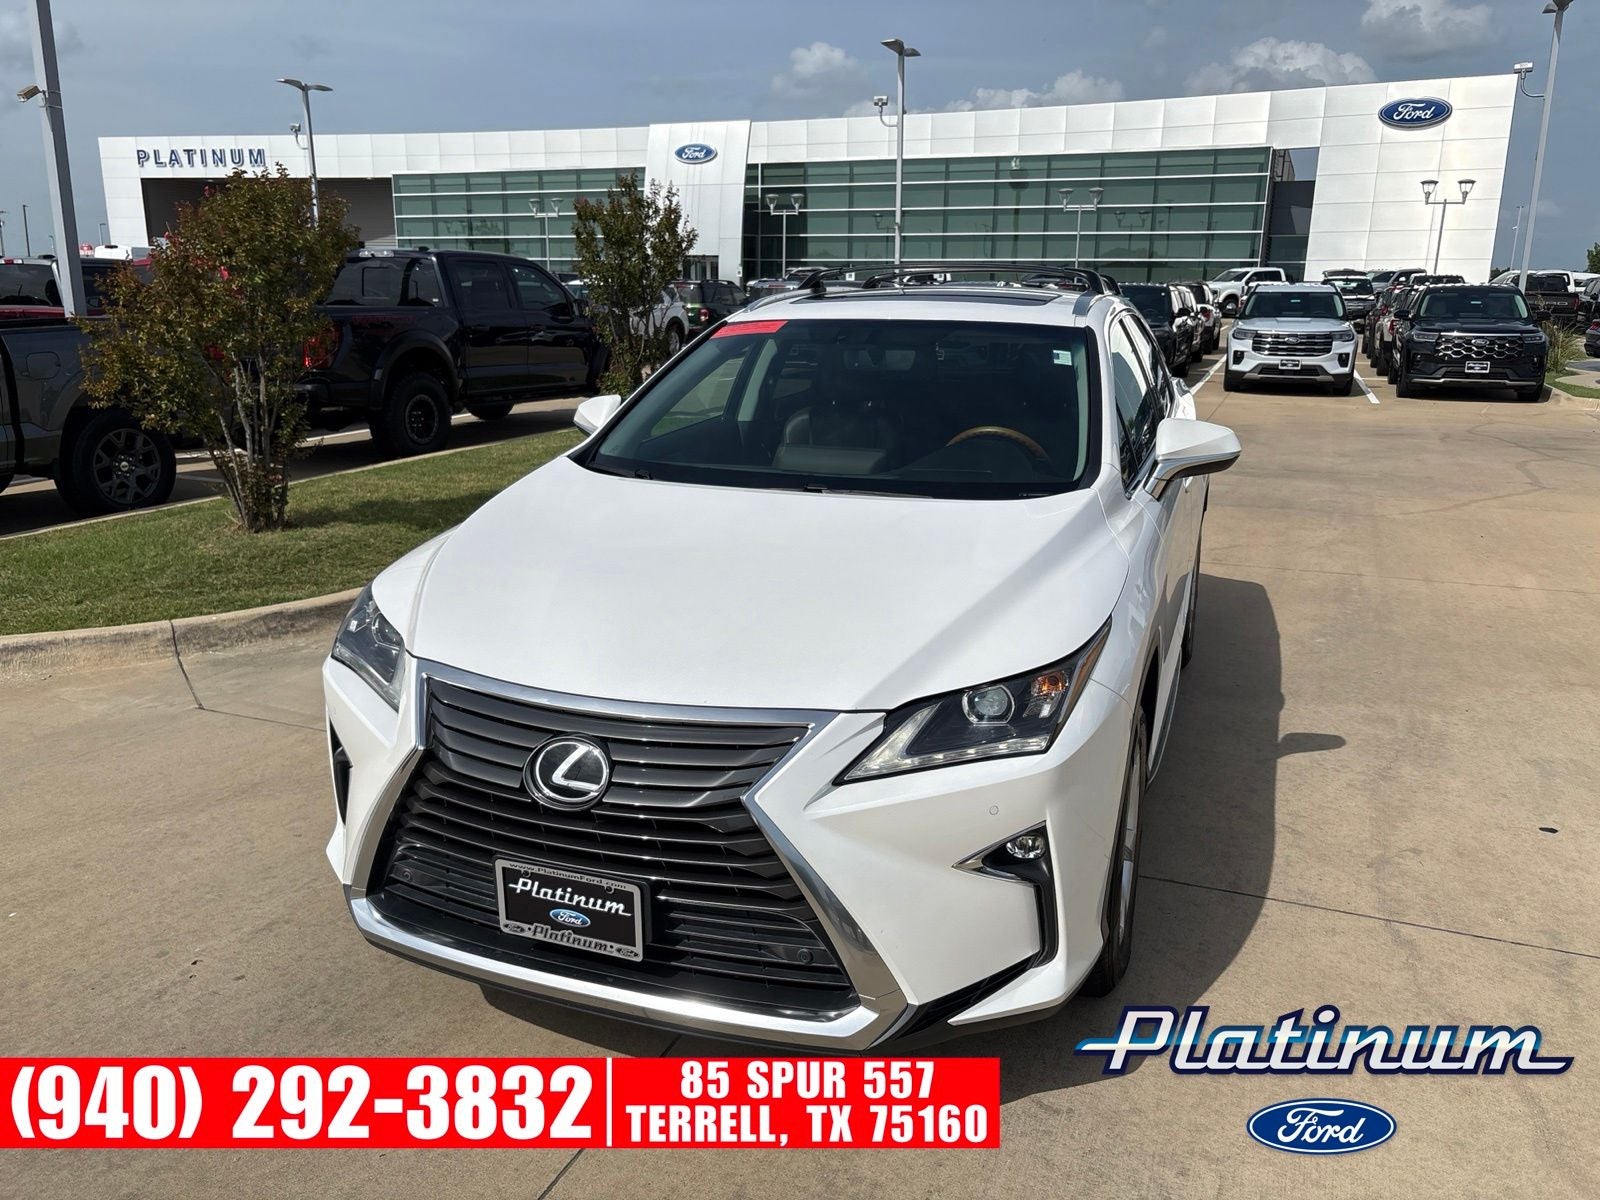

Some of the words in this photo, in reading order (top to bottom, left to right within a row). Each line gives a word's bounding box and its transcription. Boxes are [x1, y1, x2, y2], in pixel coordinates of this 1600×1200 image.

[1393, 103, 1436, 120] Ford
[136, 148, 267, 167] PLATINUM
[682, 146, 707, 159] Ford
[509, 862, 628, 890] www.PlatinumFord.com
[508, 877, 633, 917] Platinum
[557, 911, 583, 926] Ford
[532, 924, 609, 954] Platinum
